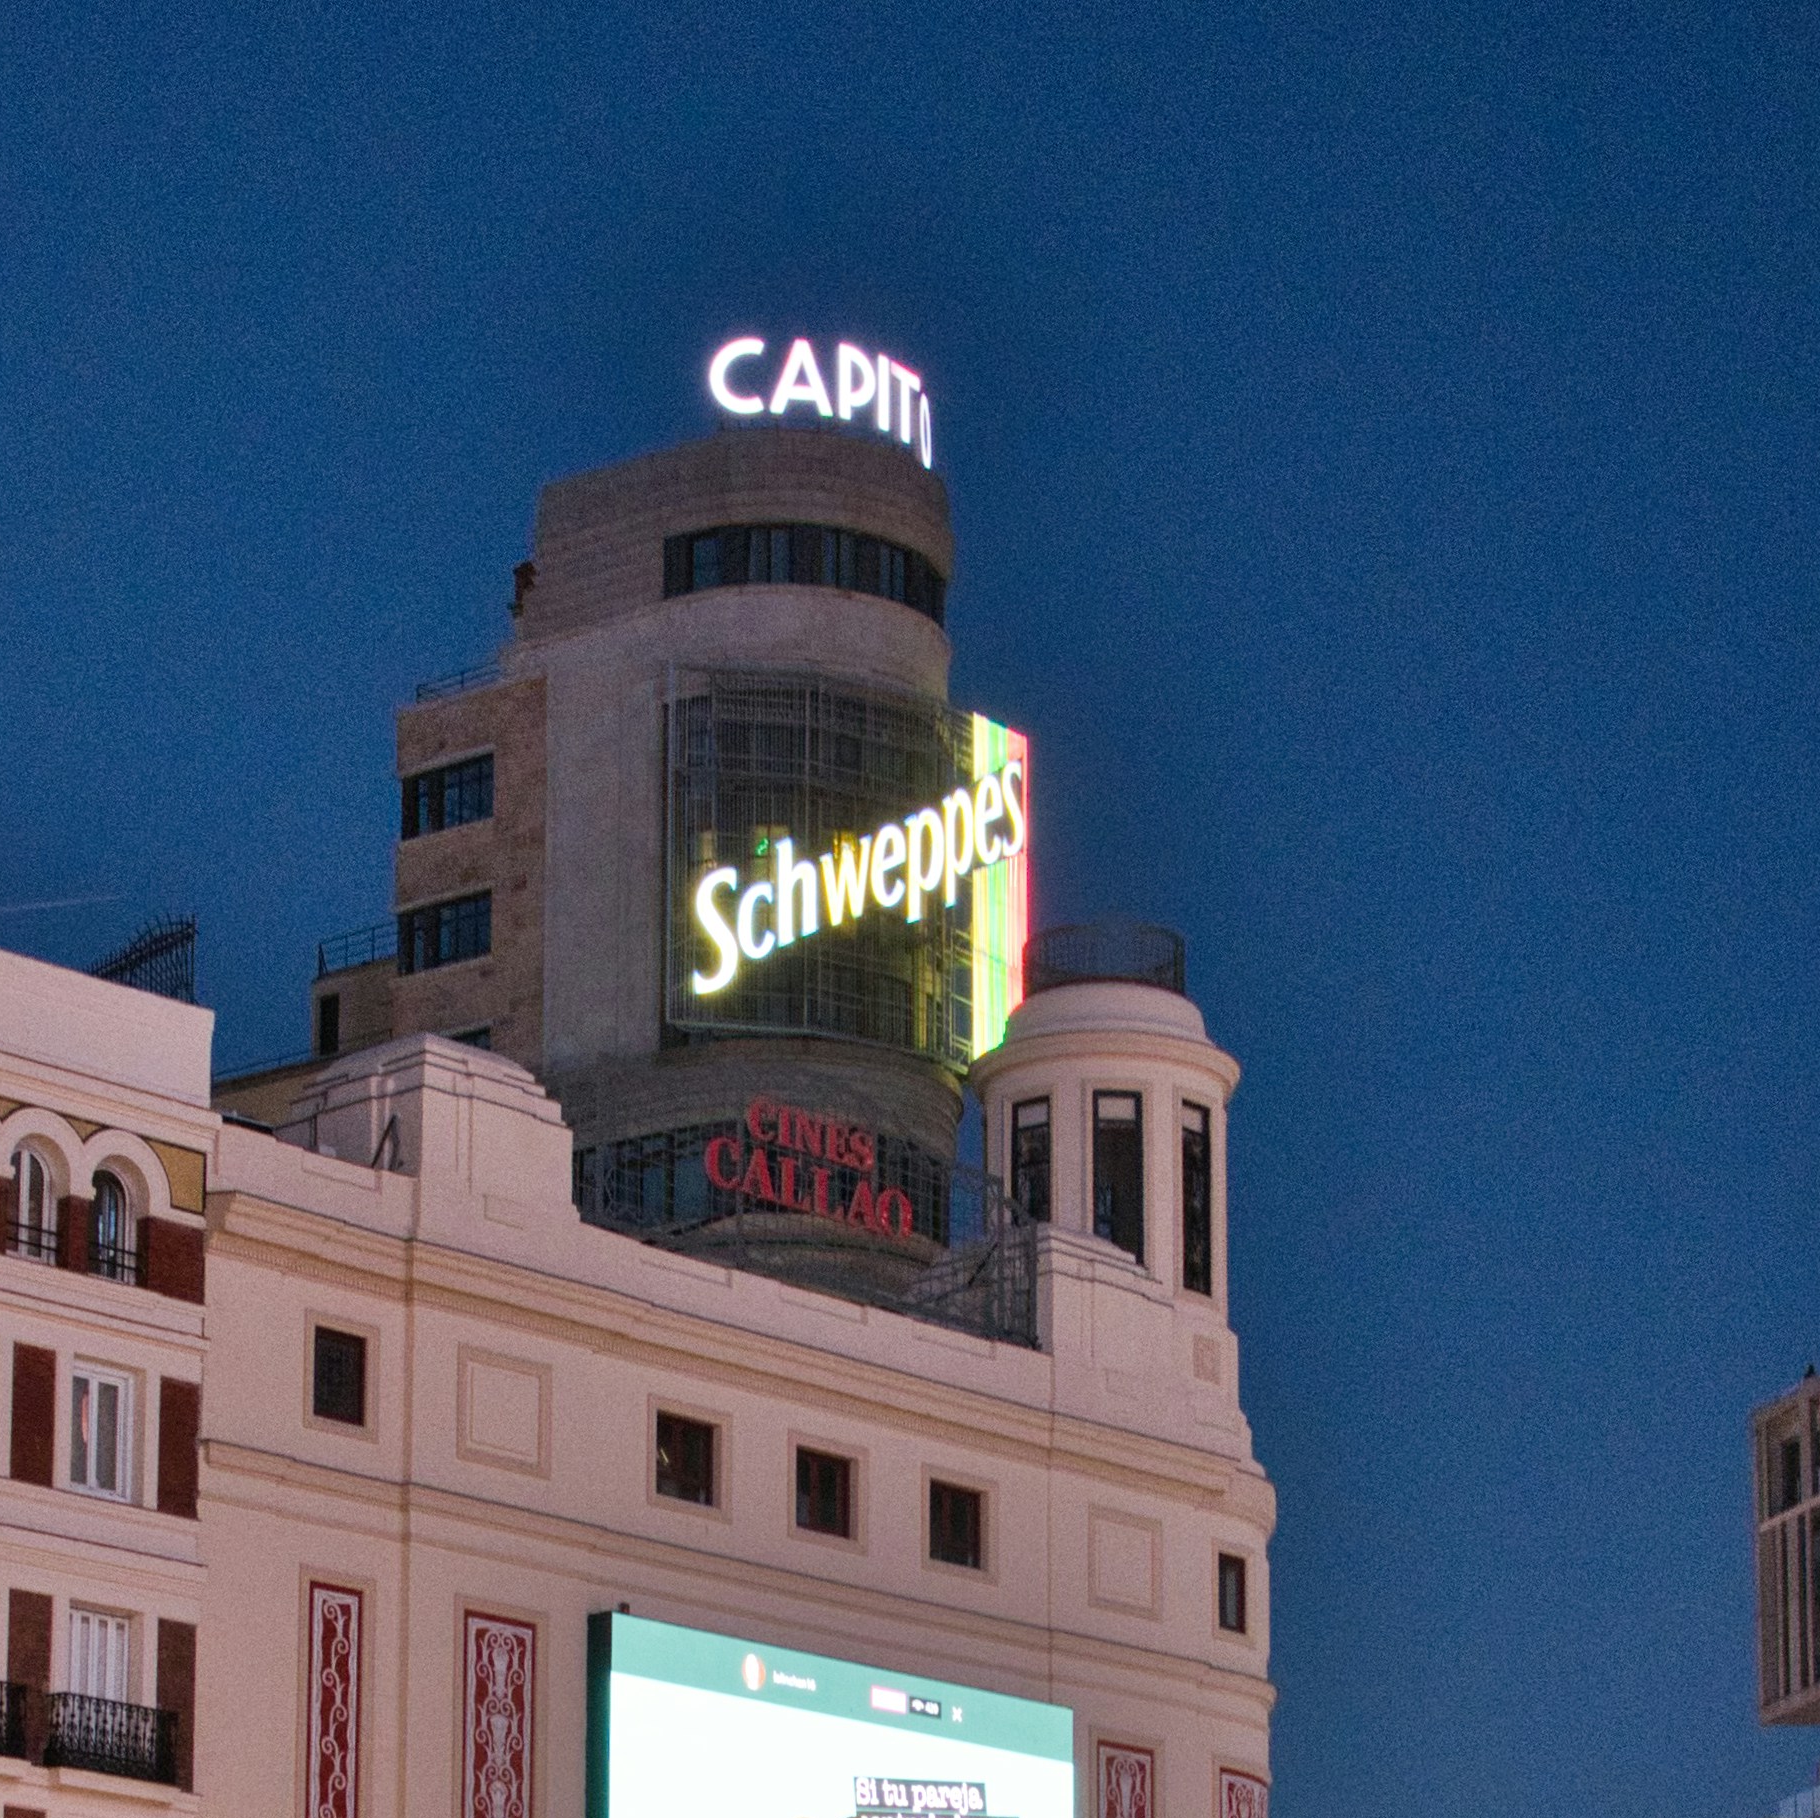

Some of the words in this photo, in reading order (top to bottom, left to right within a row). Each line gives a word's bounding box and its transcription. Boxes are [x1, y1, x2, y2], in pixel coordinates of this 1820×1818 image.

[692, 760, 1024, 995] Schweppes
[746, 1093, 875, 1173] CINES
[704, 1135, 914, 1239] CALLAO
[855, 1775, 879, 1807] Si
[882, 1778, 909, 1807] tu
[911, 1781, 984, 1816] pareja
